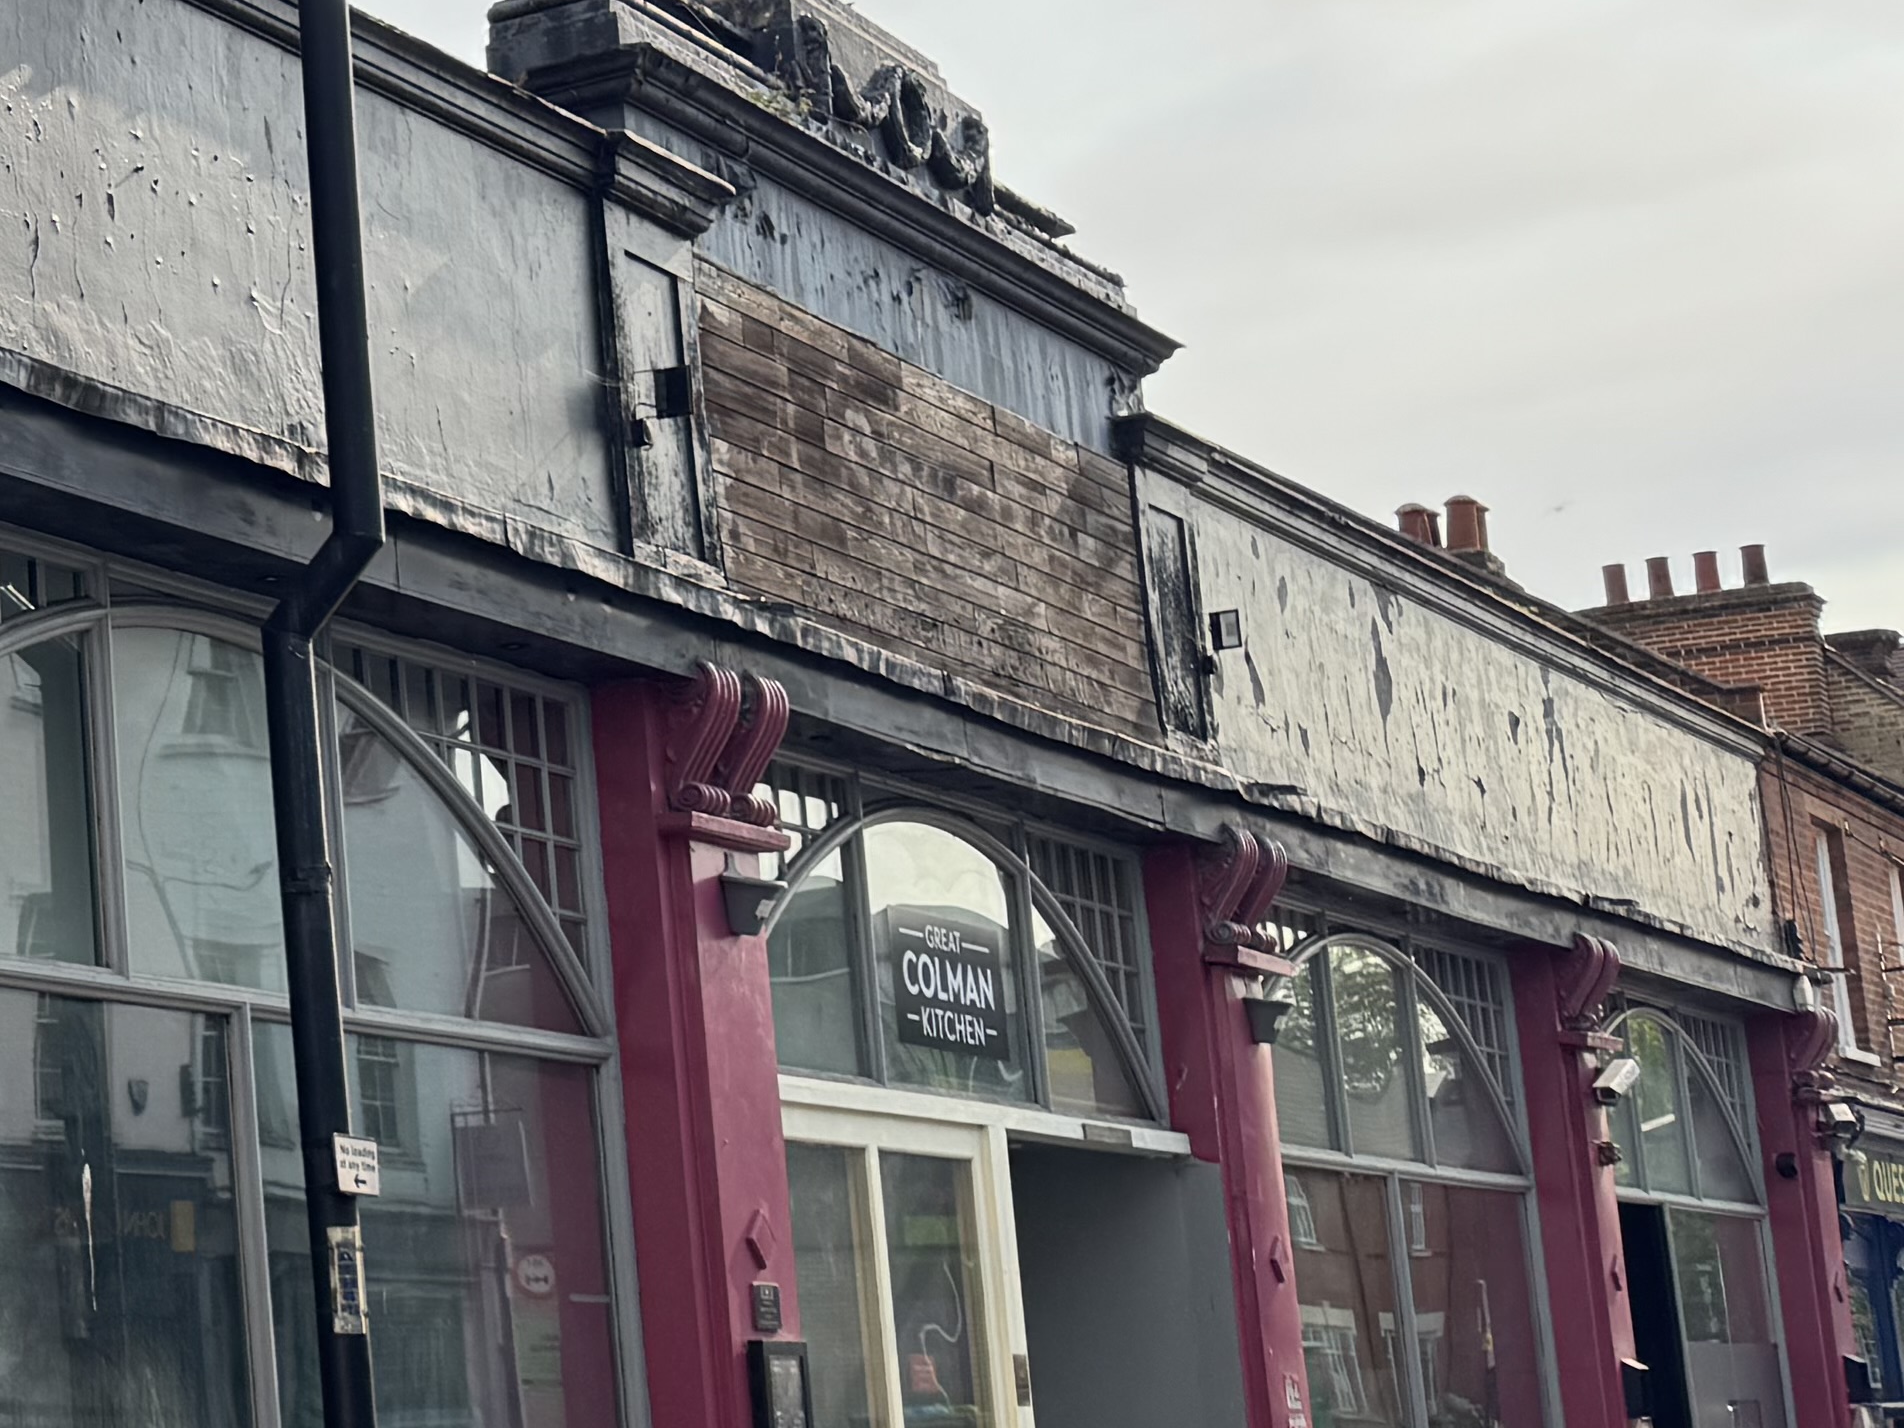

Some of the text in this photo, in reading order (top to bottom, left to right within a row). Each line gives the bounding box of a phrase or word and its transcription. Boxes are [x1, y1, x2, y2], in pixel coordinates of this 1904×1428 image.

[924, 924, 961, 954] GREAT
[902, 949, 996, 1011] COLMAN
[920, 1006, 987, 1047] KITCHEN
